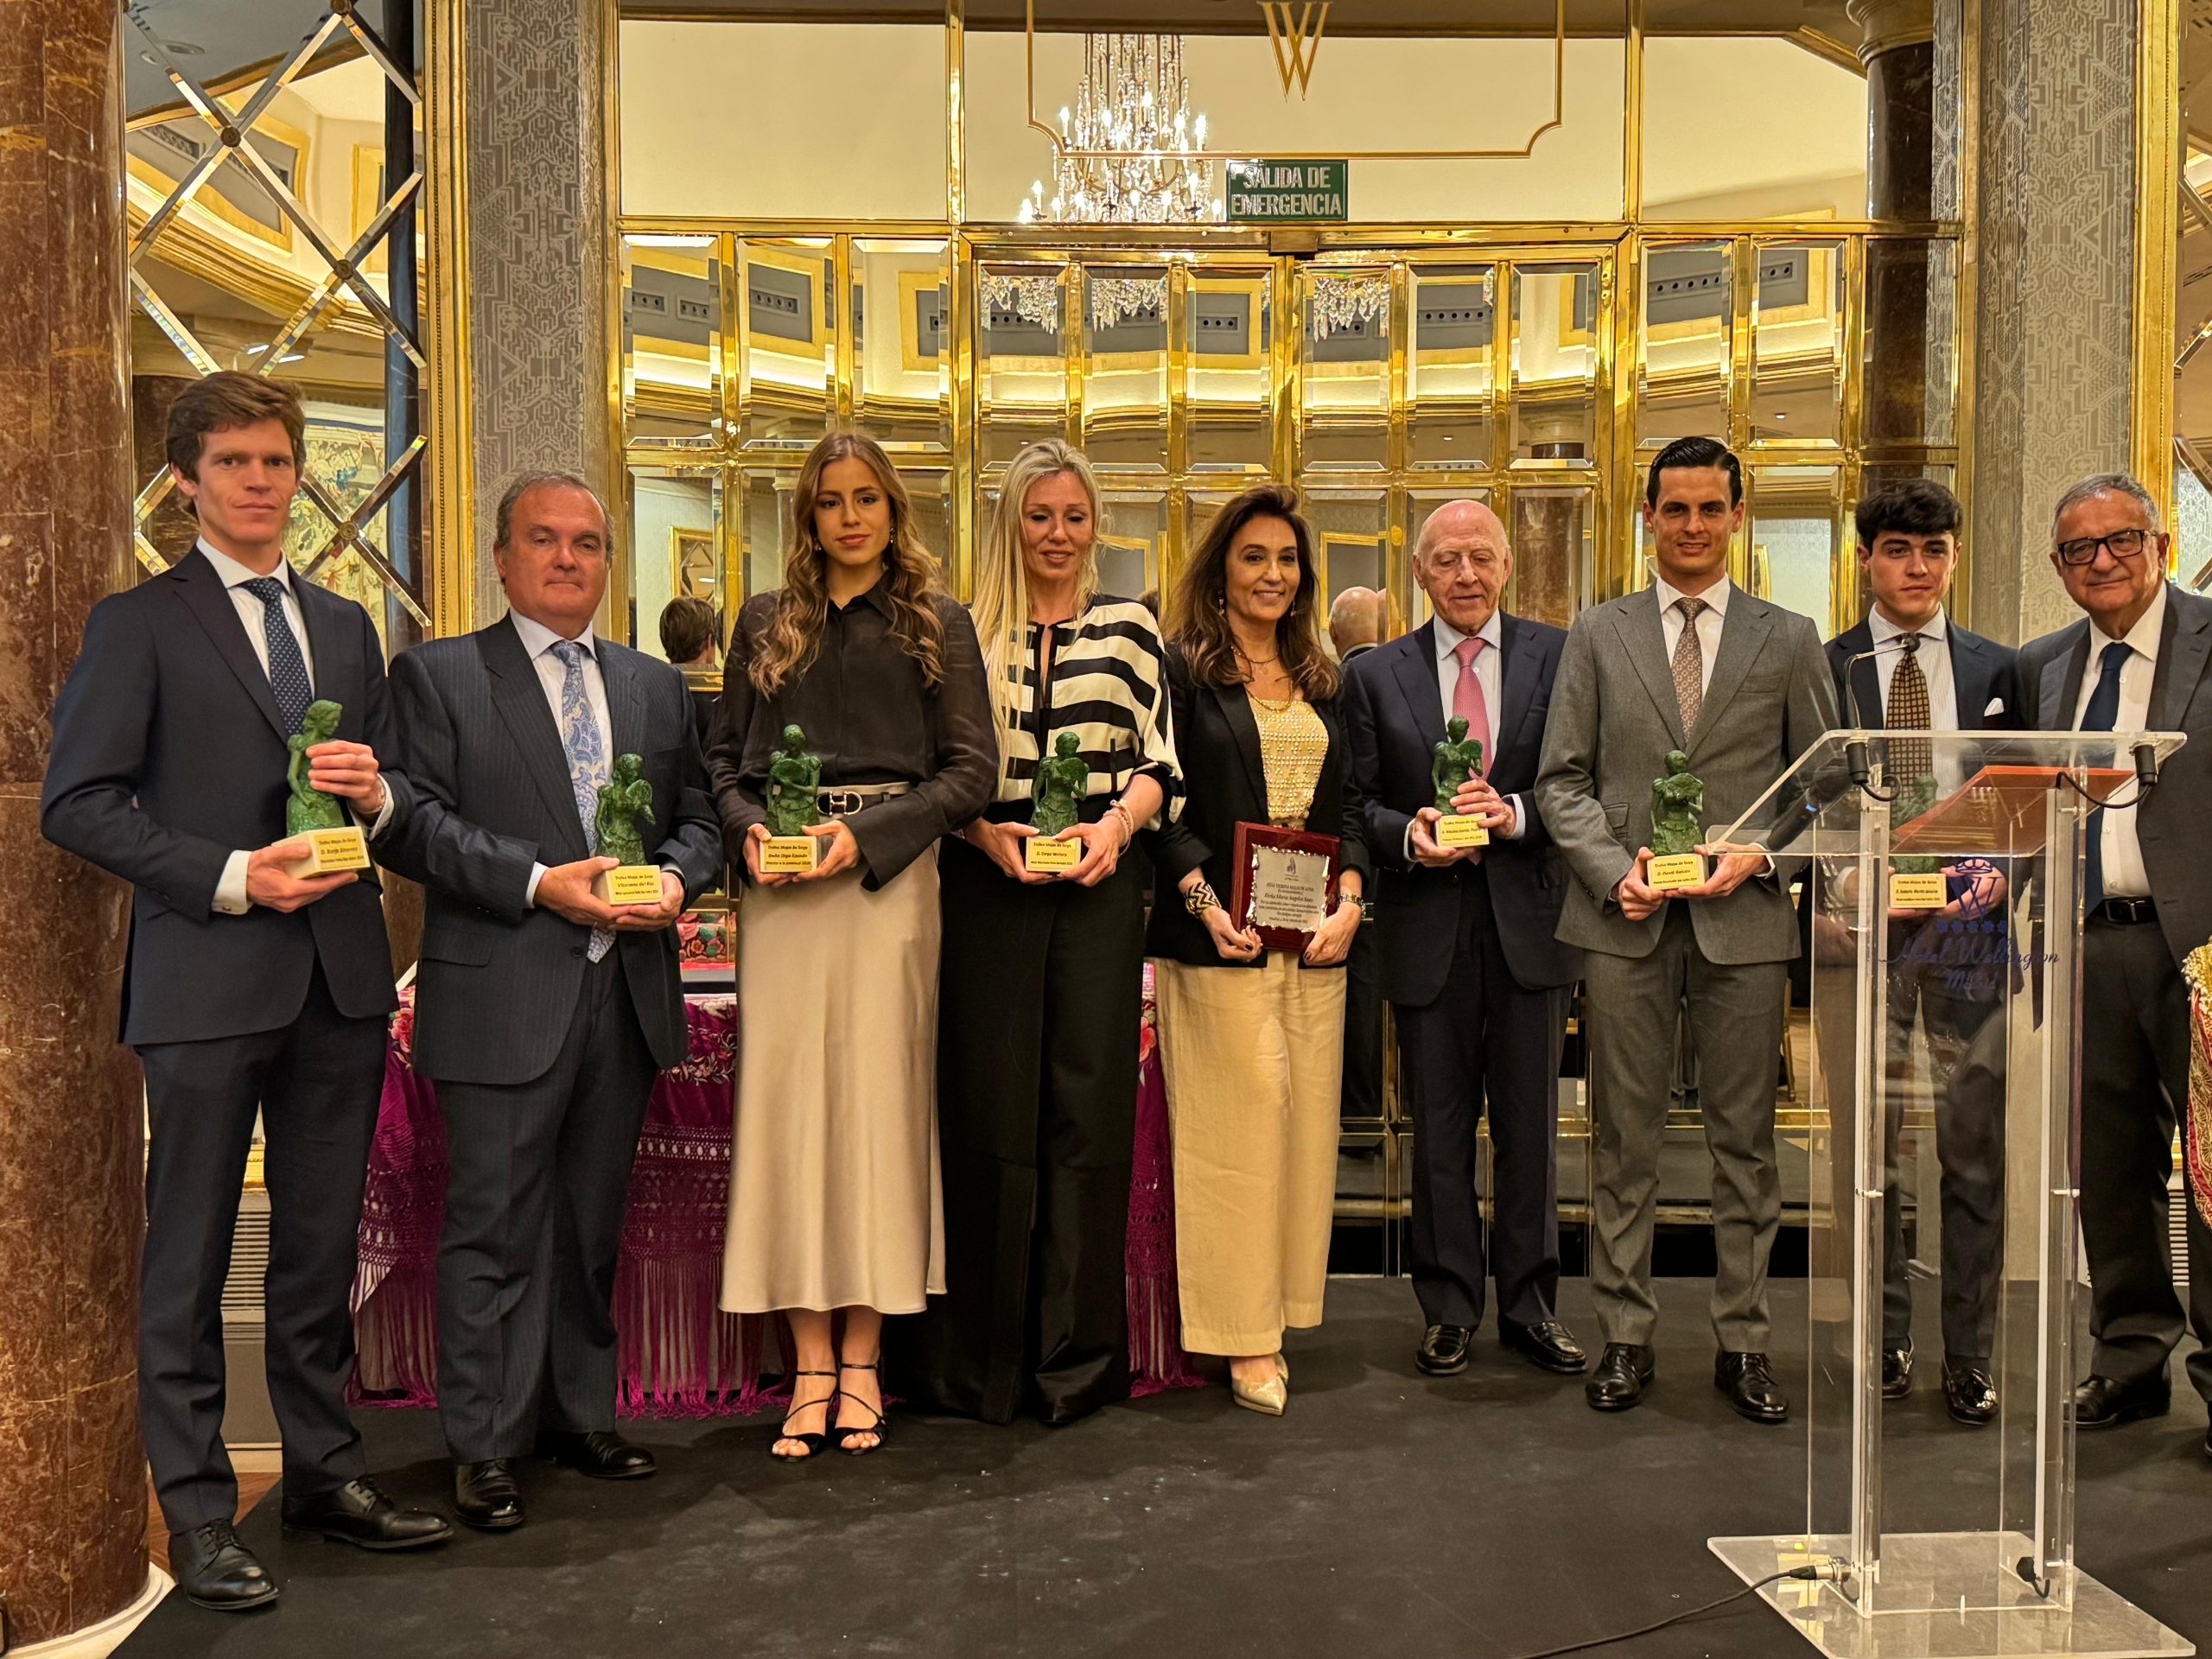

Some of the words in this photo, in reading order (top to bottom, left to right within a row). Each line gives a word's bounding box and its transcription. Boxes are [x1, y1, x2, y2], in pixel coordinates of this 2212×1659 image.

[1243, 166, 1303, 189] SALIDA
[1307, 166, 1332, 188] DE
[1230, 193, 1342, 215] EMERGENCIA
[1955, 935, 2060, 970] Wellingon
